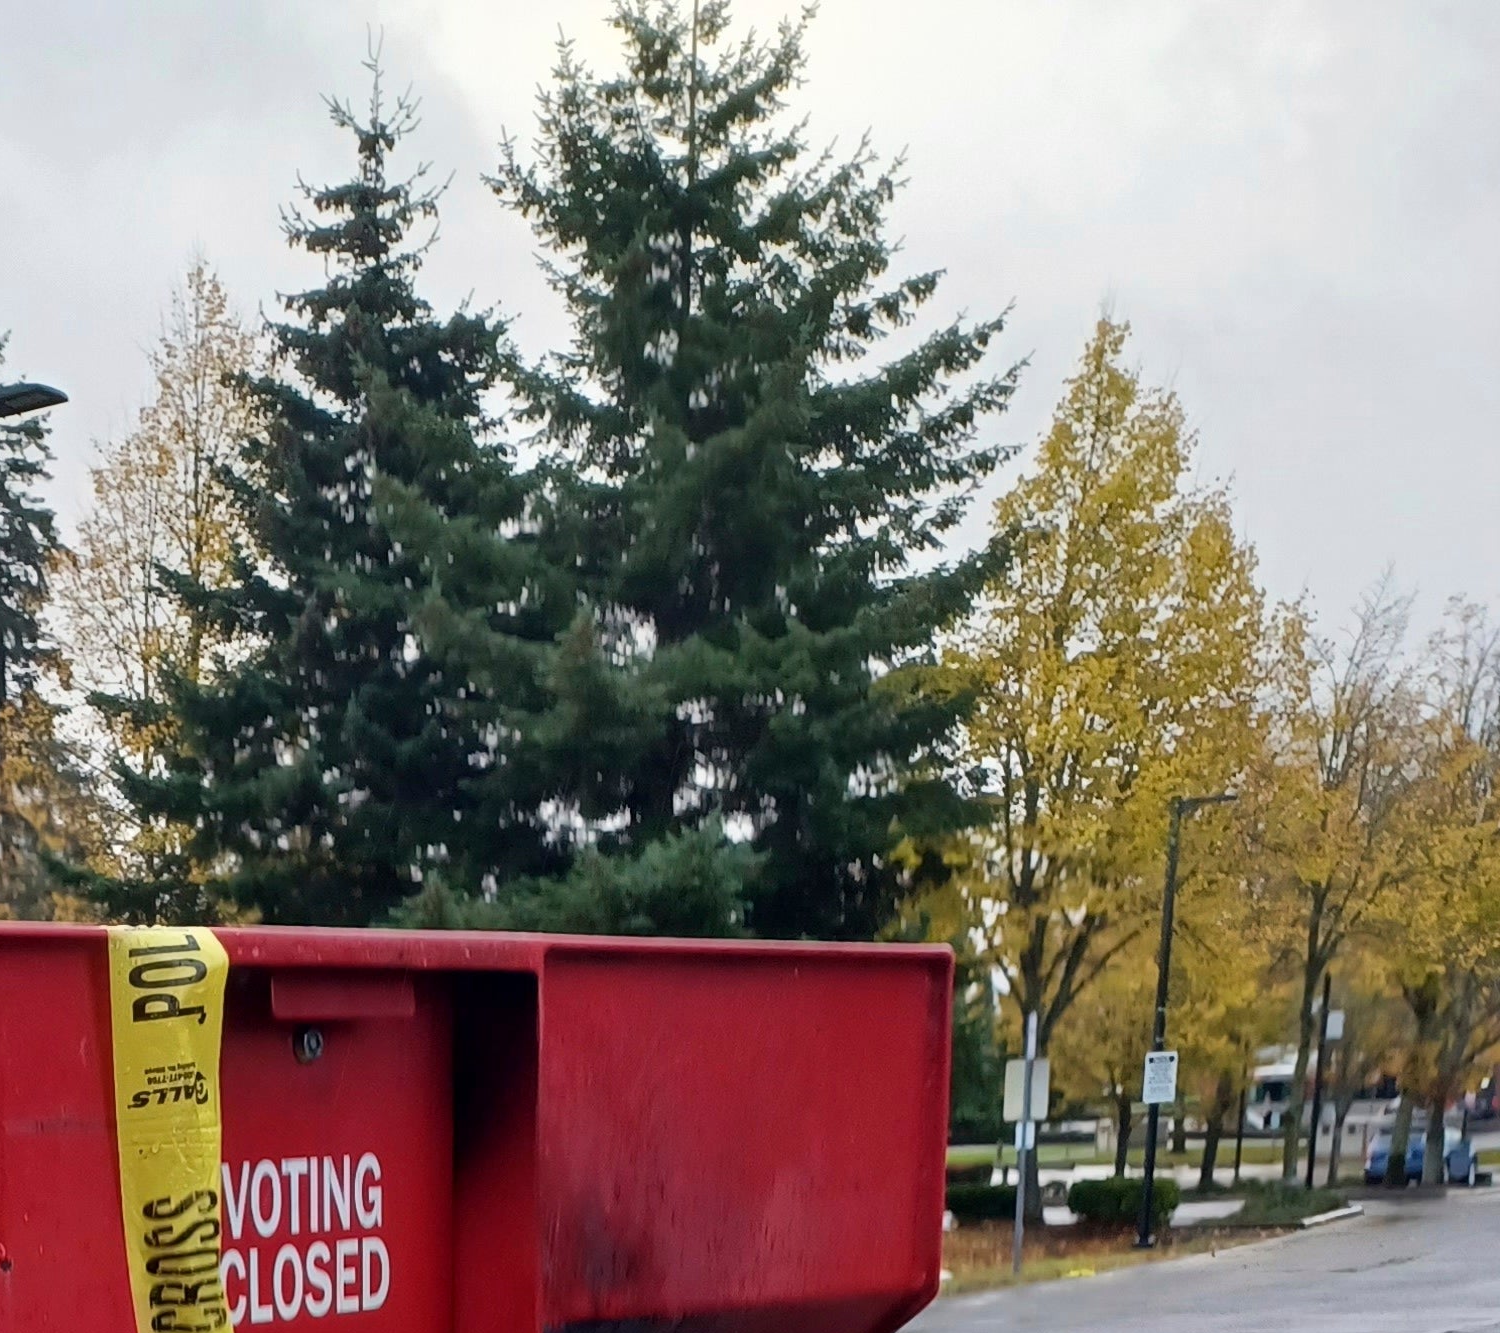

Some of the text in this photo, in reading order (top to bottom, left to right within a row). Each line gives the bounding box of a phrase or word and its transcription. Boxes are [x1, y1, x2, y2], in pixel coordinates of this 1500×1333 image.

[219, 1151, 384, 1242] VOTING
[141, 1187, 228, 1333] CROSS
[219, 1236, 391, 1327] CLOSED
